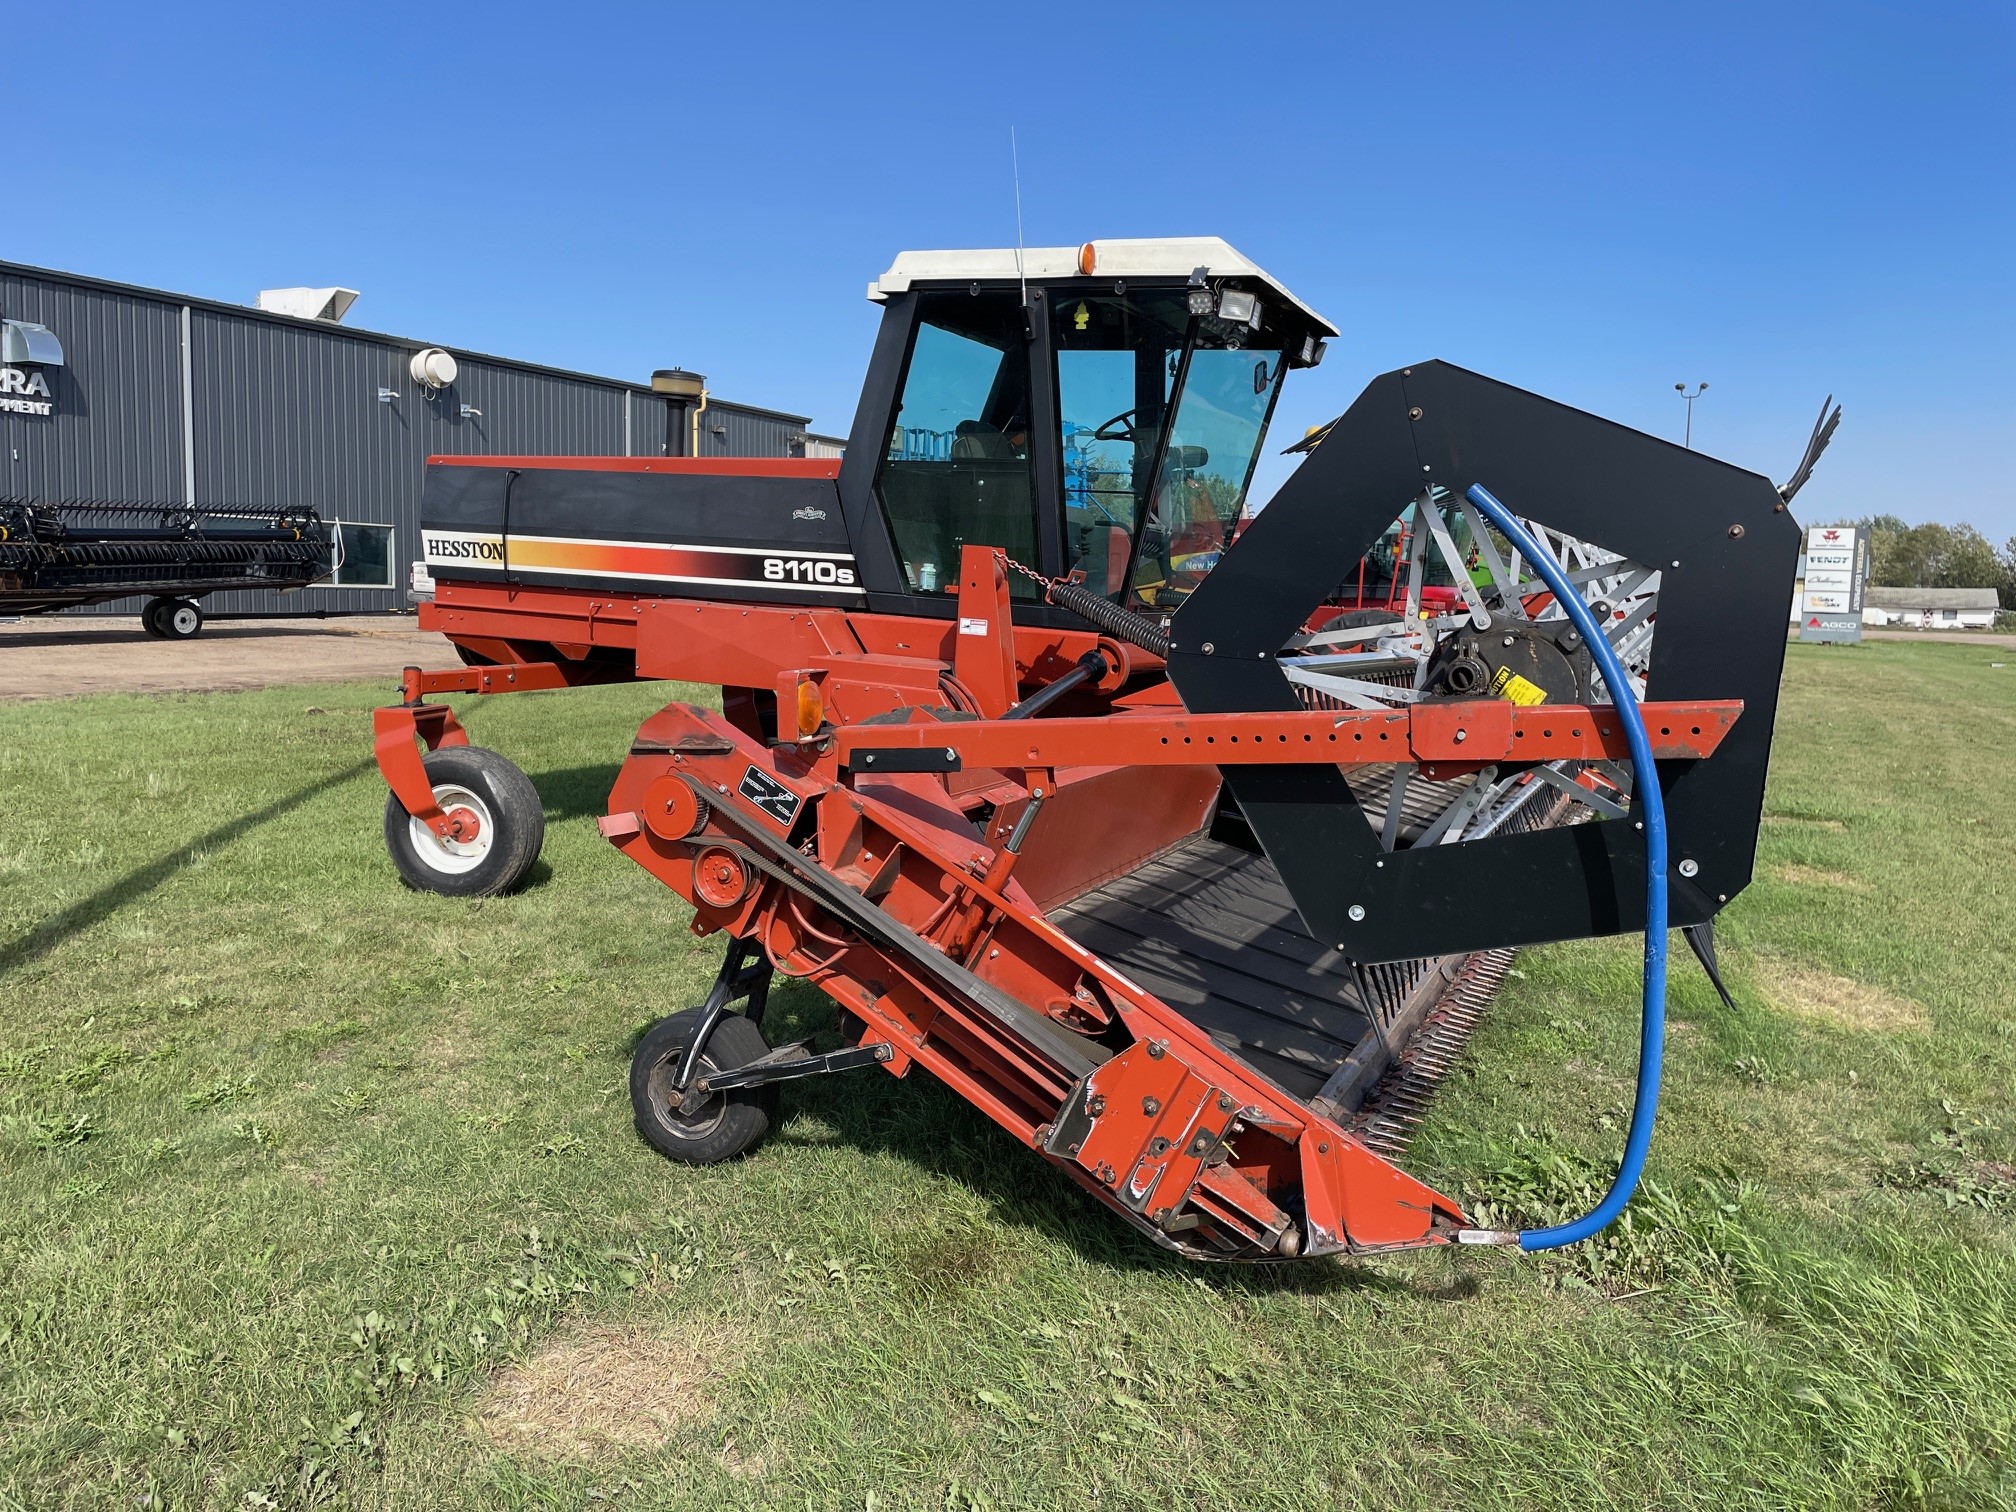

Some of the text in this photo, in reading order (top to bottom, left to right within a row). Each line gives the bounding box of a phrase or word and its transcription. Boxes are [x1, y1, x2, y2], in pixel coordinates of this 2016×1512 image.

[0, 367, 51, 398] RA
[428, 539, 504, 560] HESSTON
[763, 558, 855, 584] 8110s
[1186, 562, 1204, 570] New
